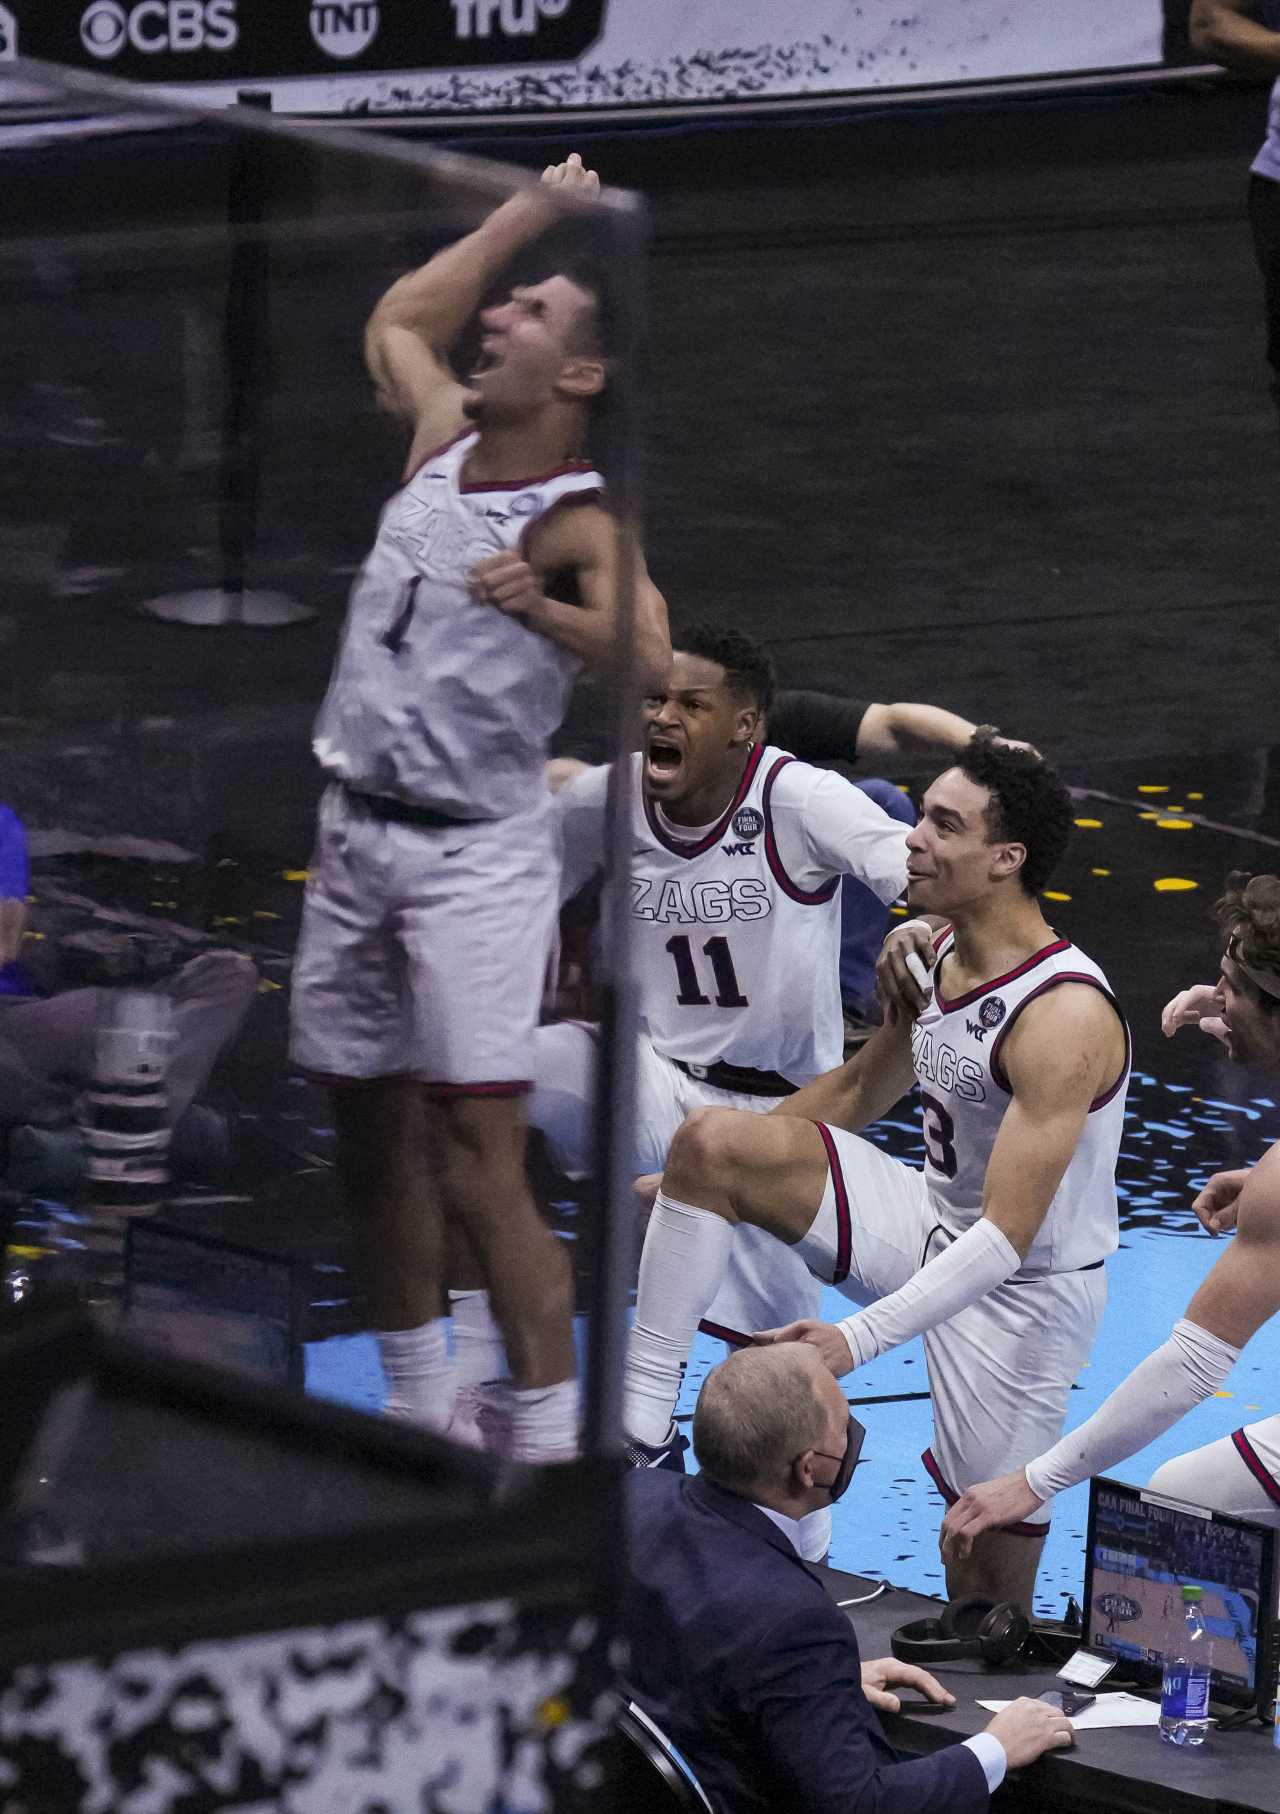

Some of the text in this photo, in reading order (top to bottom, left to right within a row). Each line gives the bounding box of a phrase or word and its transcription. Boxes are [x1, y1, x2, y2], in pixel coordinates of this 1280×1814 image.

[128, 0, 238, 50] CBS
[310, 5, 377, 34] TNT
[631, 876, 771, 924] ZAGS
[665, 935, 749, 1008] 11
